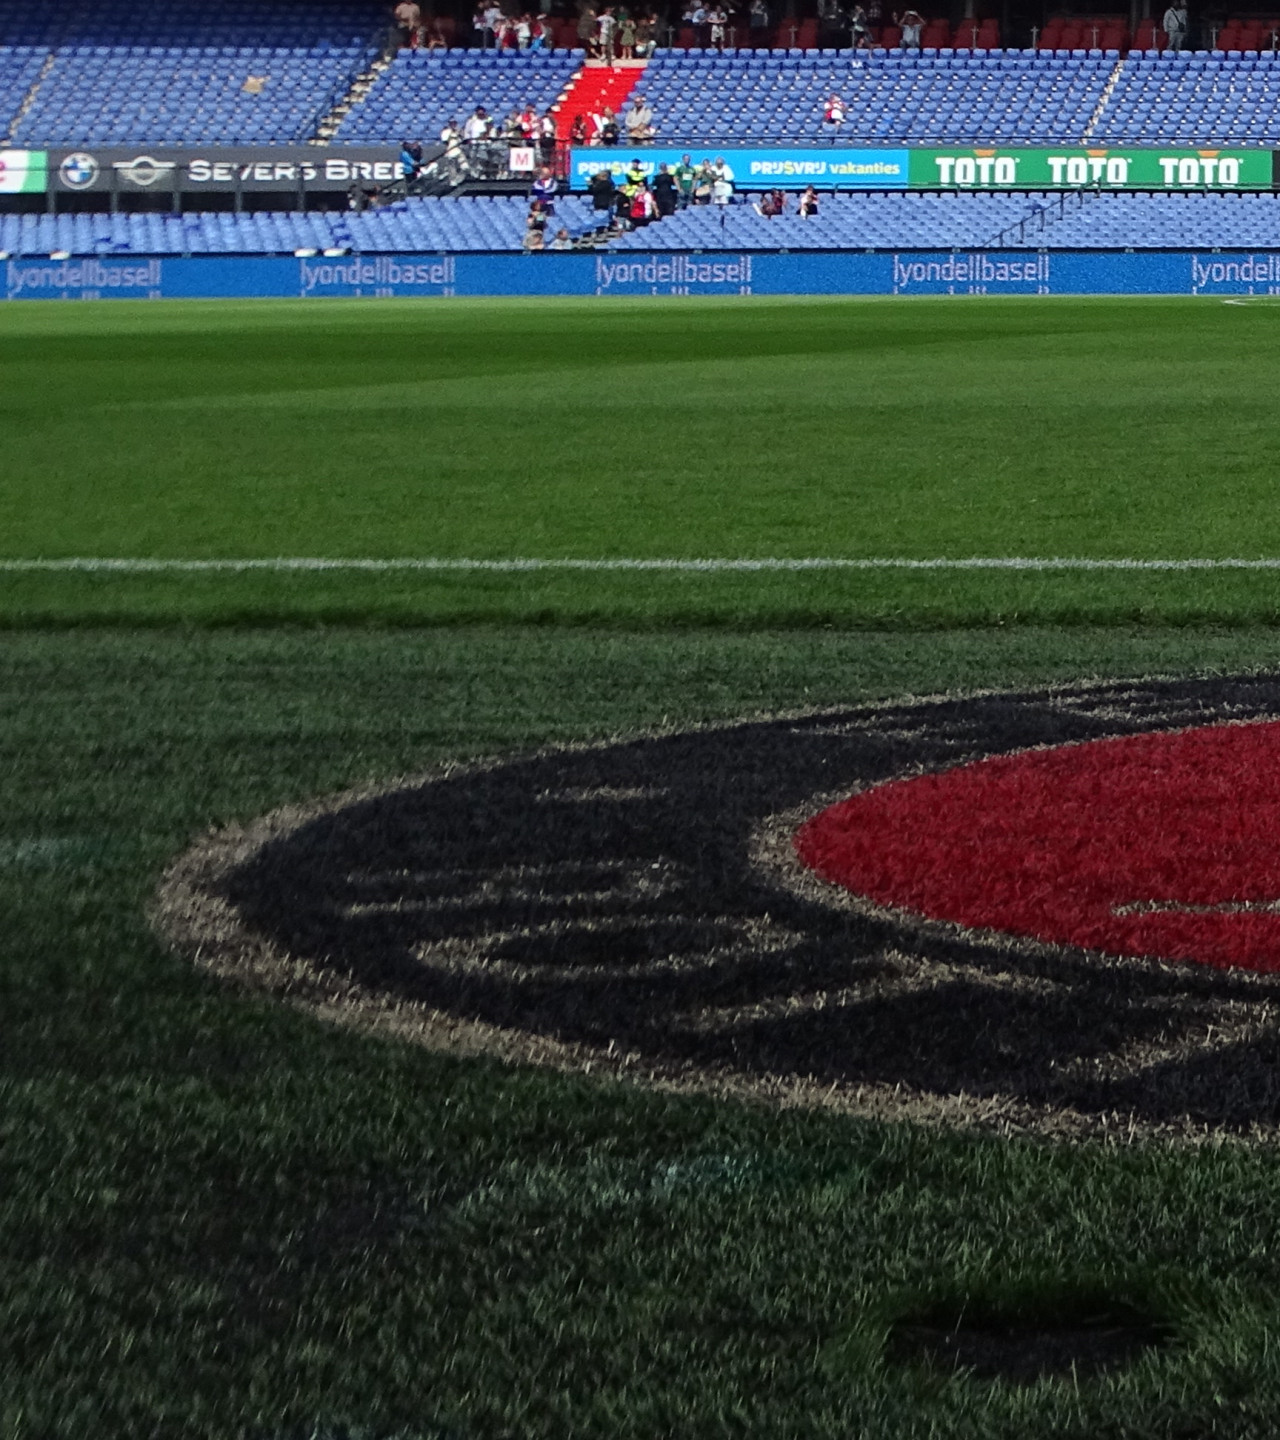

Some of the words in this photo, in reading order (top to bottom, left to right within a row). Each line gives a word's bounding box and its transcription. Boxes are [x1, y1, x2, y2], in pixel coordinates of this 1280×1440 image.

[515, 153, 529, 166] M
[829, 163, 900, 176] vakanties
[935, 157, 1016, 187] TOTO
[1047, 157, 1128, 187] TOTO
[1159, 157, 1240, 187] TOTO
[7, 258, 161, 290] lyondellbasell
[301, 257, 455, 289] lyondellbasell
[596, 255, 751, 286] lyondellbasell
[893, 254, 1049, 286] lyondellbasell
